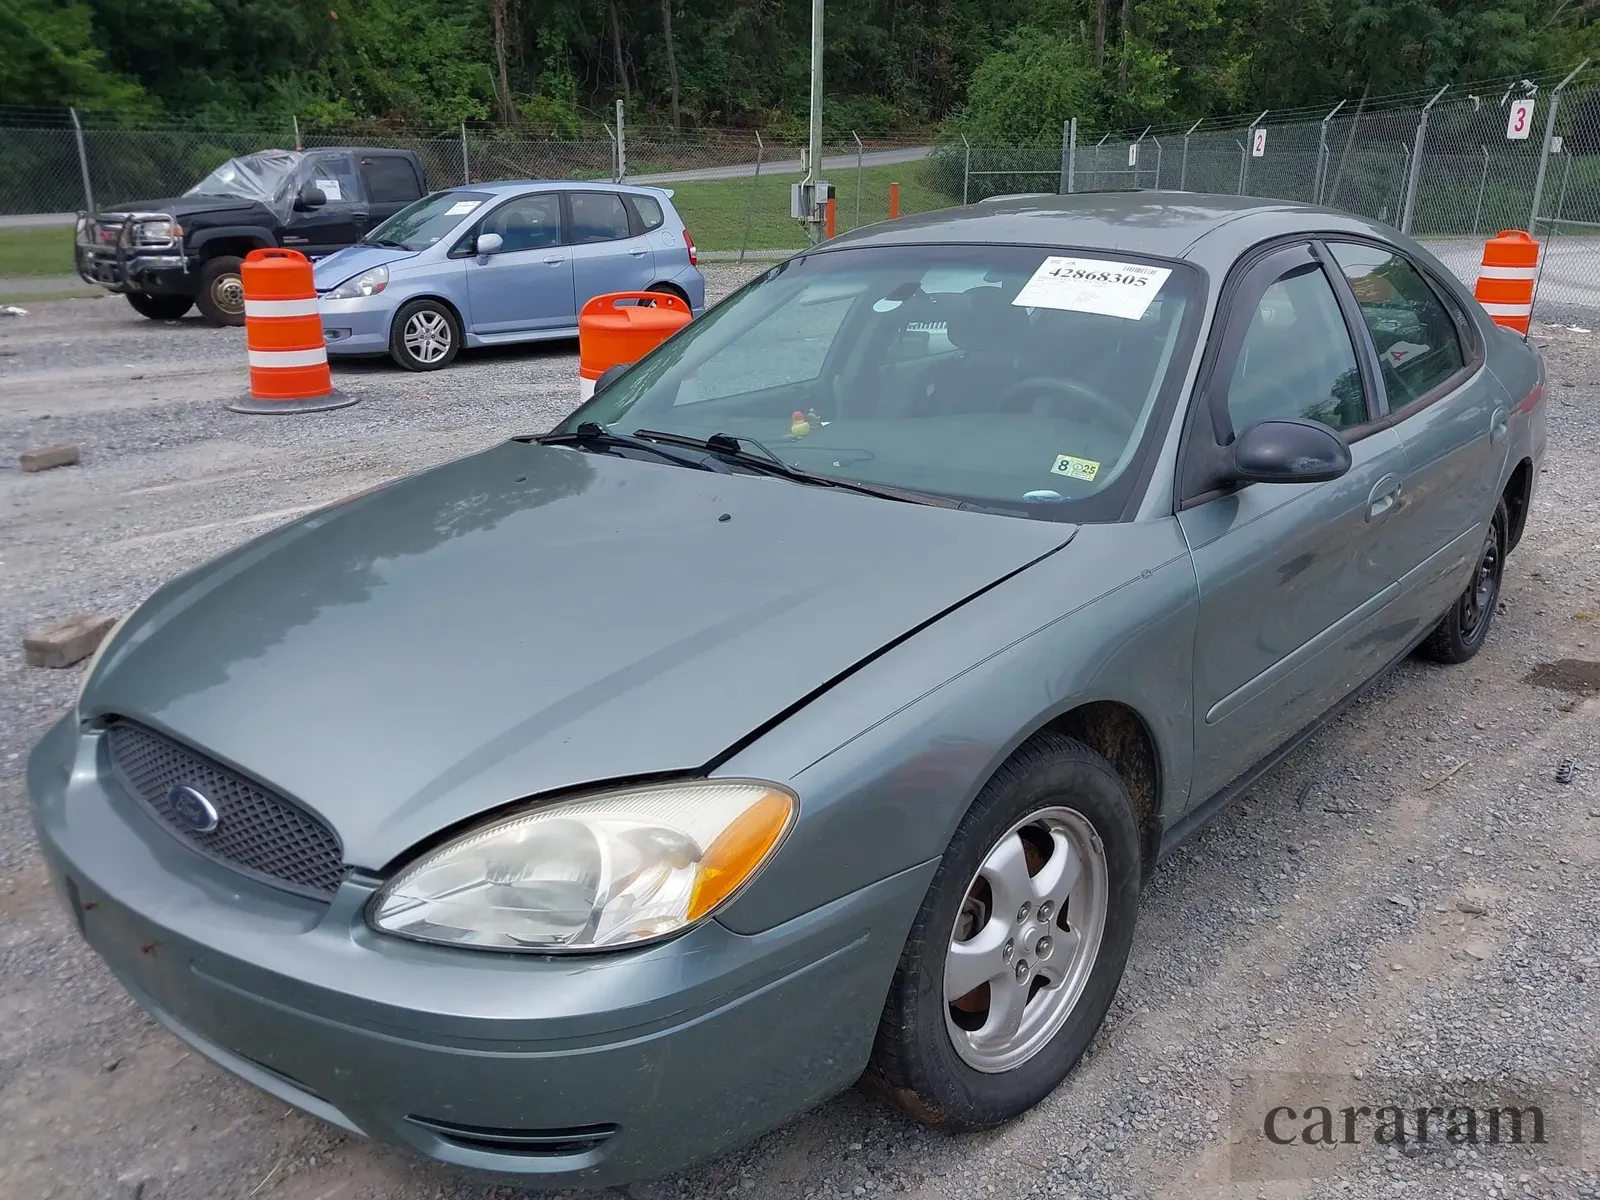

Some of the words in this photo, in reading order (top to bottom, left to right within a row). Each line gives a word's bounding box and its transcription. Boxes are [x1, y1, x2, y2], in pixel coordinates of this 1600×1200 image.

[1514, 107, 1526, 132] 3
[1256, 134, 1263, 152] 2
[1049, 267, 1149, 288] 42868305
[1058, 459, 1069, 471] 8
[1082, 464, 1096, 475] 25
